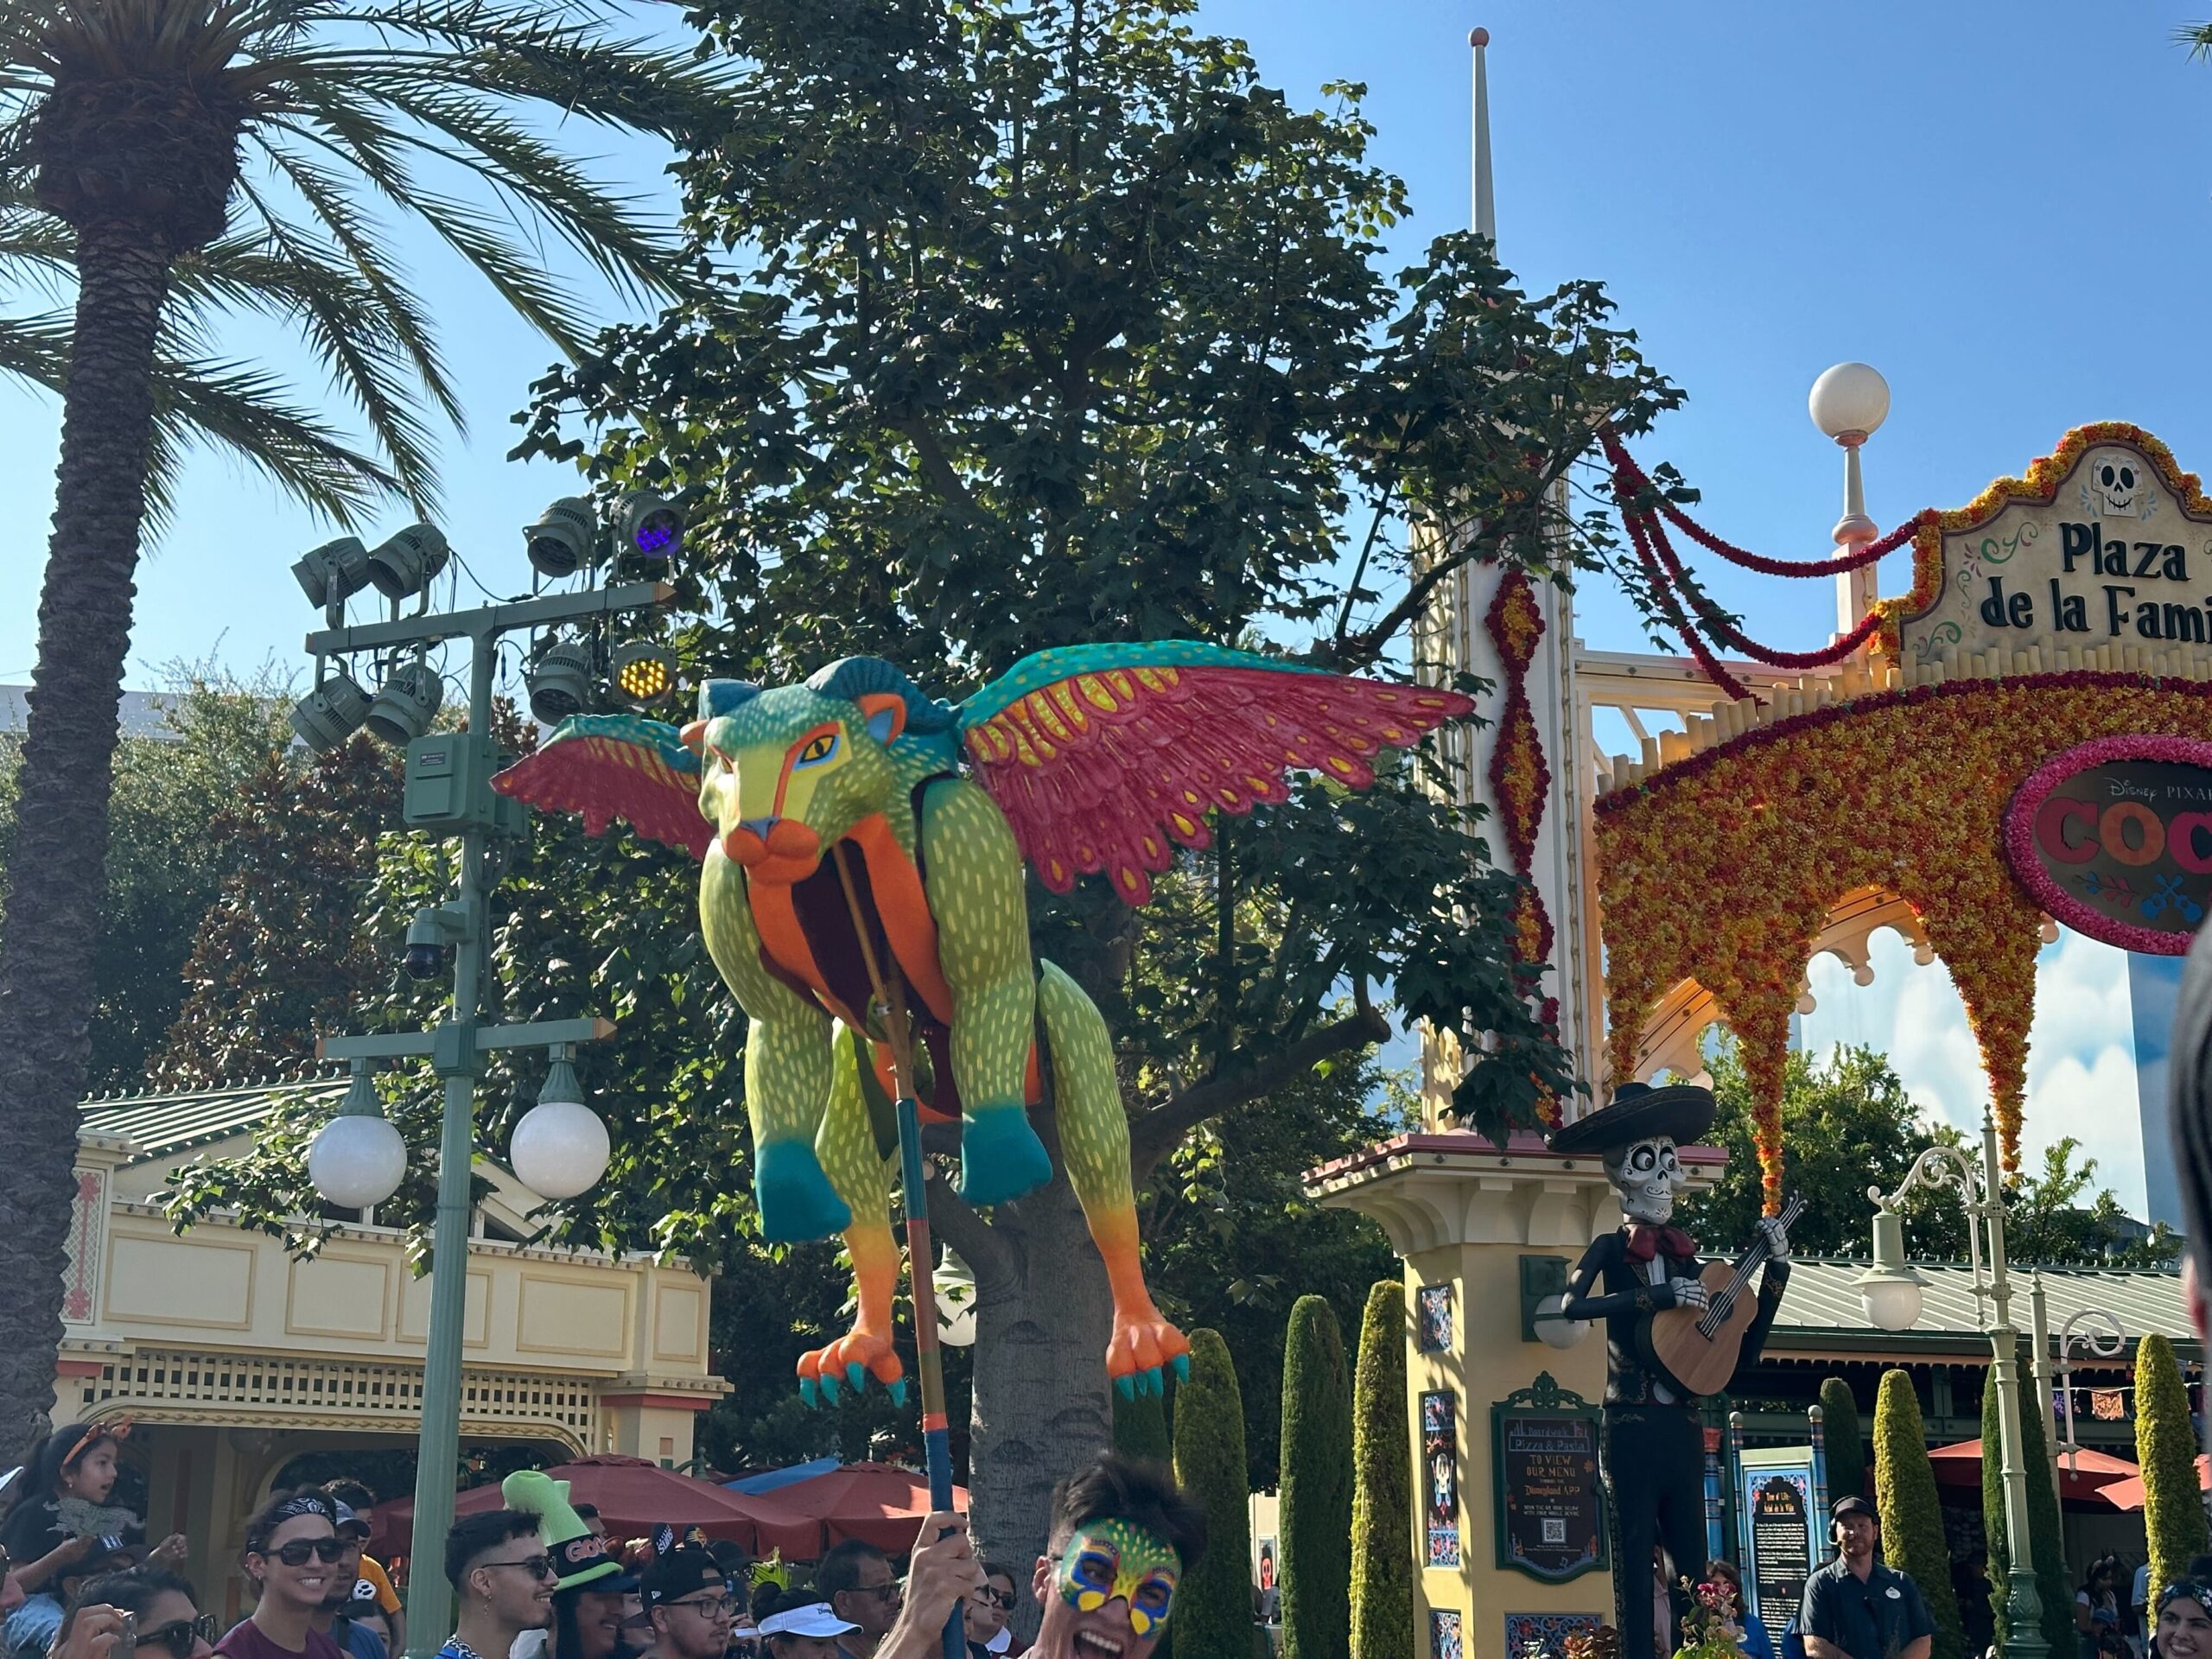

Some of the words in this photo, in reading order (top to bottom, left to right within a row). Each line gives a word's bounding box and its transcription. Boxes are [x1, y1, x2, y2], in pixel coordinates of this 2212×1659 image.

[2059, 522, 2191, 582] Plaza
[1980, 576, 2033, 628] de
[2050, 578, 2092, 632] la
[2103, 777, 2158, 803] Disney
[1515, 1439, 1543, 1451] Pizza
[1546, 1440, 1554, 1452] &
[1556, 1440, 1585, 1452] Pasta
[1529, 1454, 1542, 1465] TO
[1545, 1455, 1572, 1465] VIEW
[1526, 1466, 1546, 1478] OUR
[1548, 1466, 1576, 1478] MENU
[1564, 1485, 1580, 1496] APP
